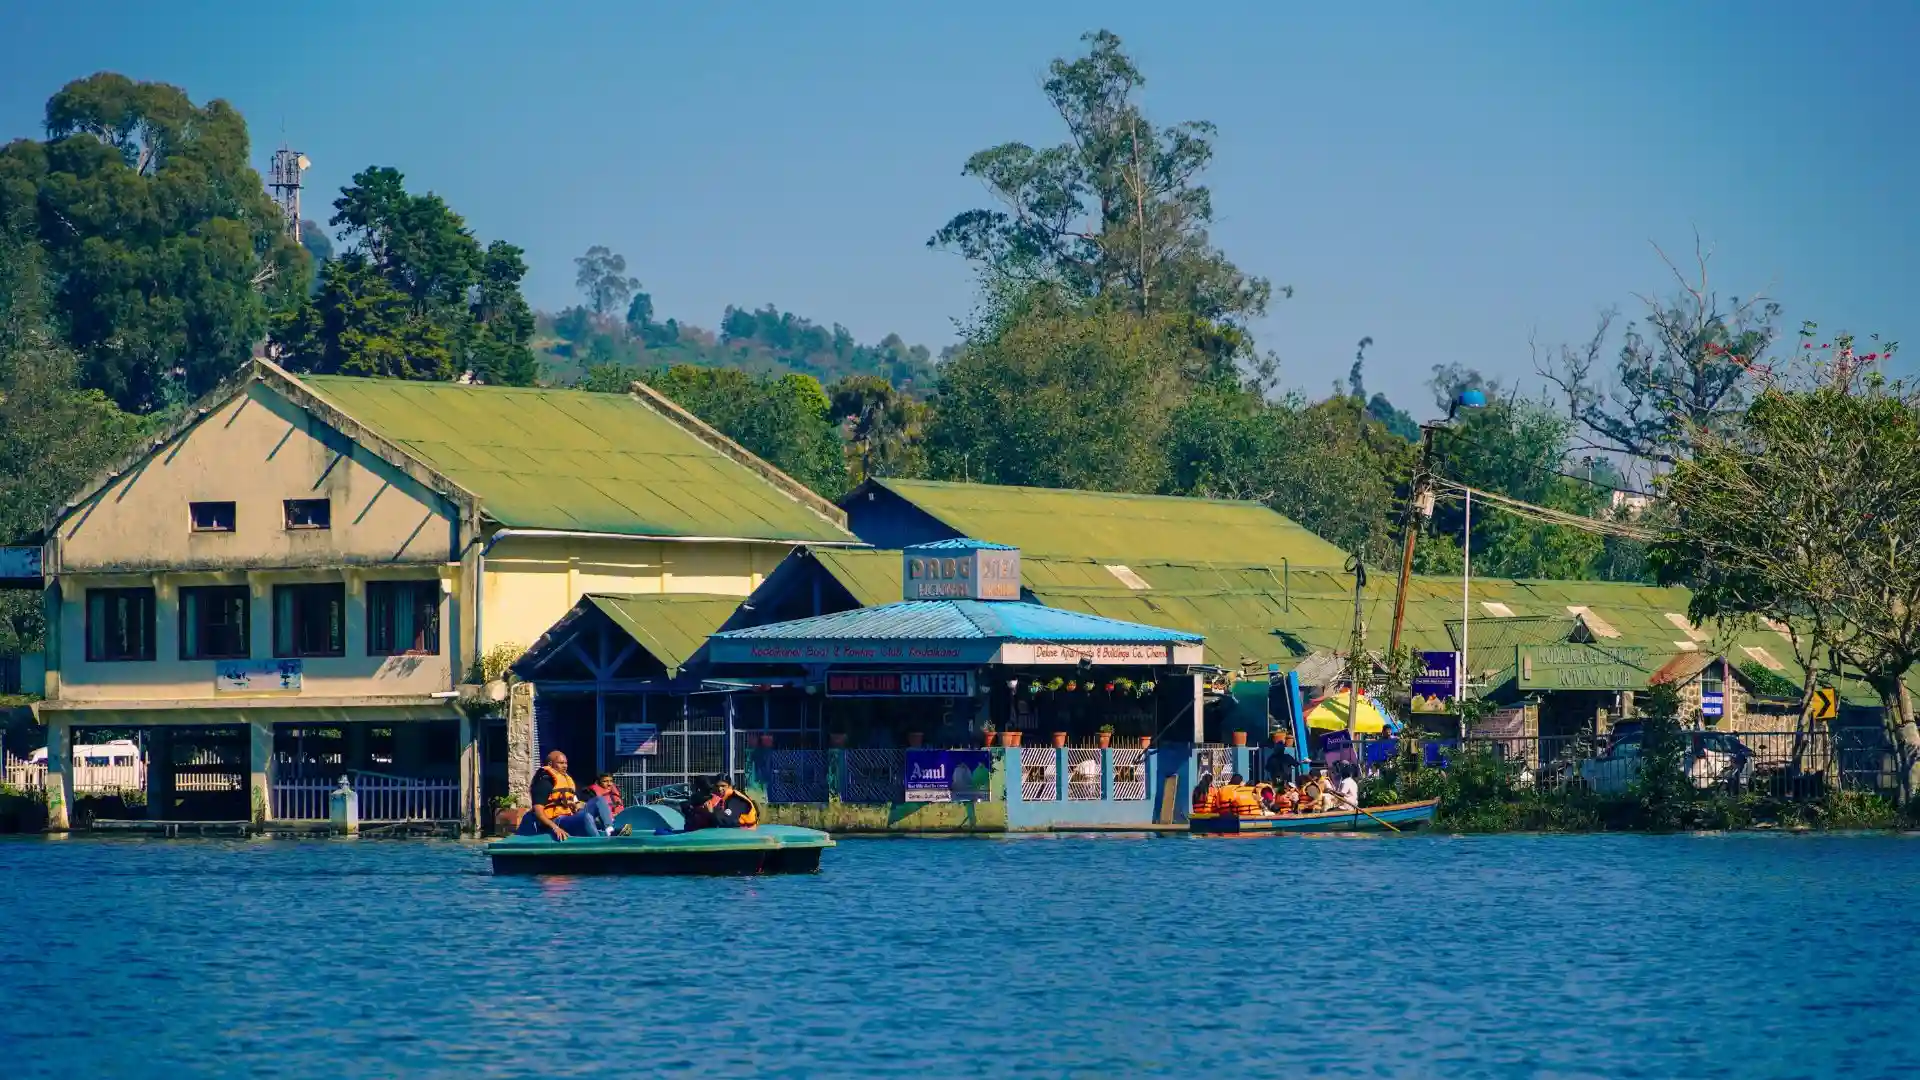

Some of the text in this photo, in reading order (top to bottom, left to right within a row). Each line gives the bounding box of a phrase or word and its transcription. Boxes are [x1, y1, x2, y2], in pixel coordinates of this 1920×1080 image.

[1417, 665, 1450, 677] Amul
[900, 674, 965, 693] CANTEEN
[910, 762, 946, 780] Amul
